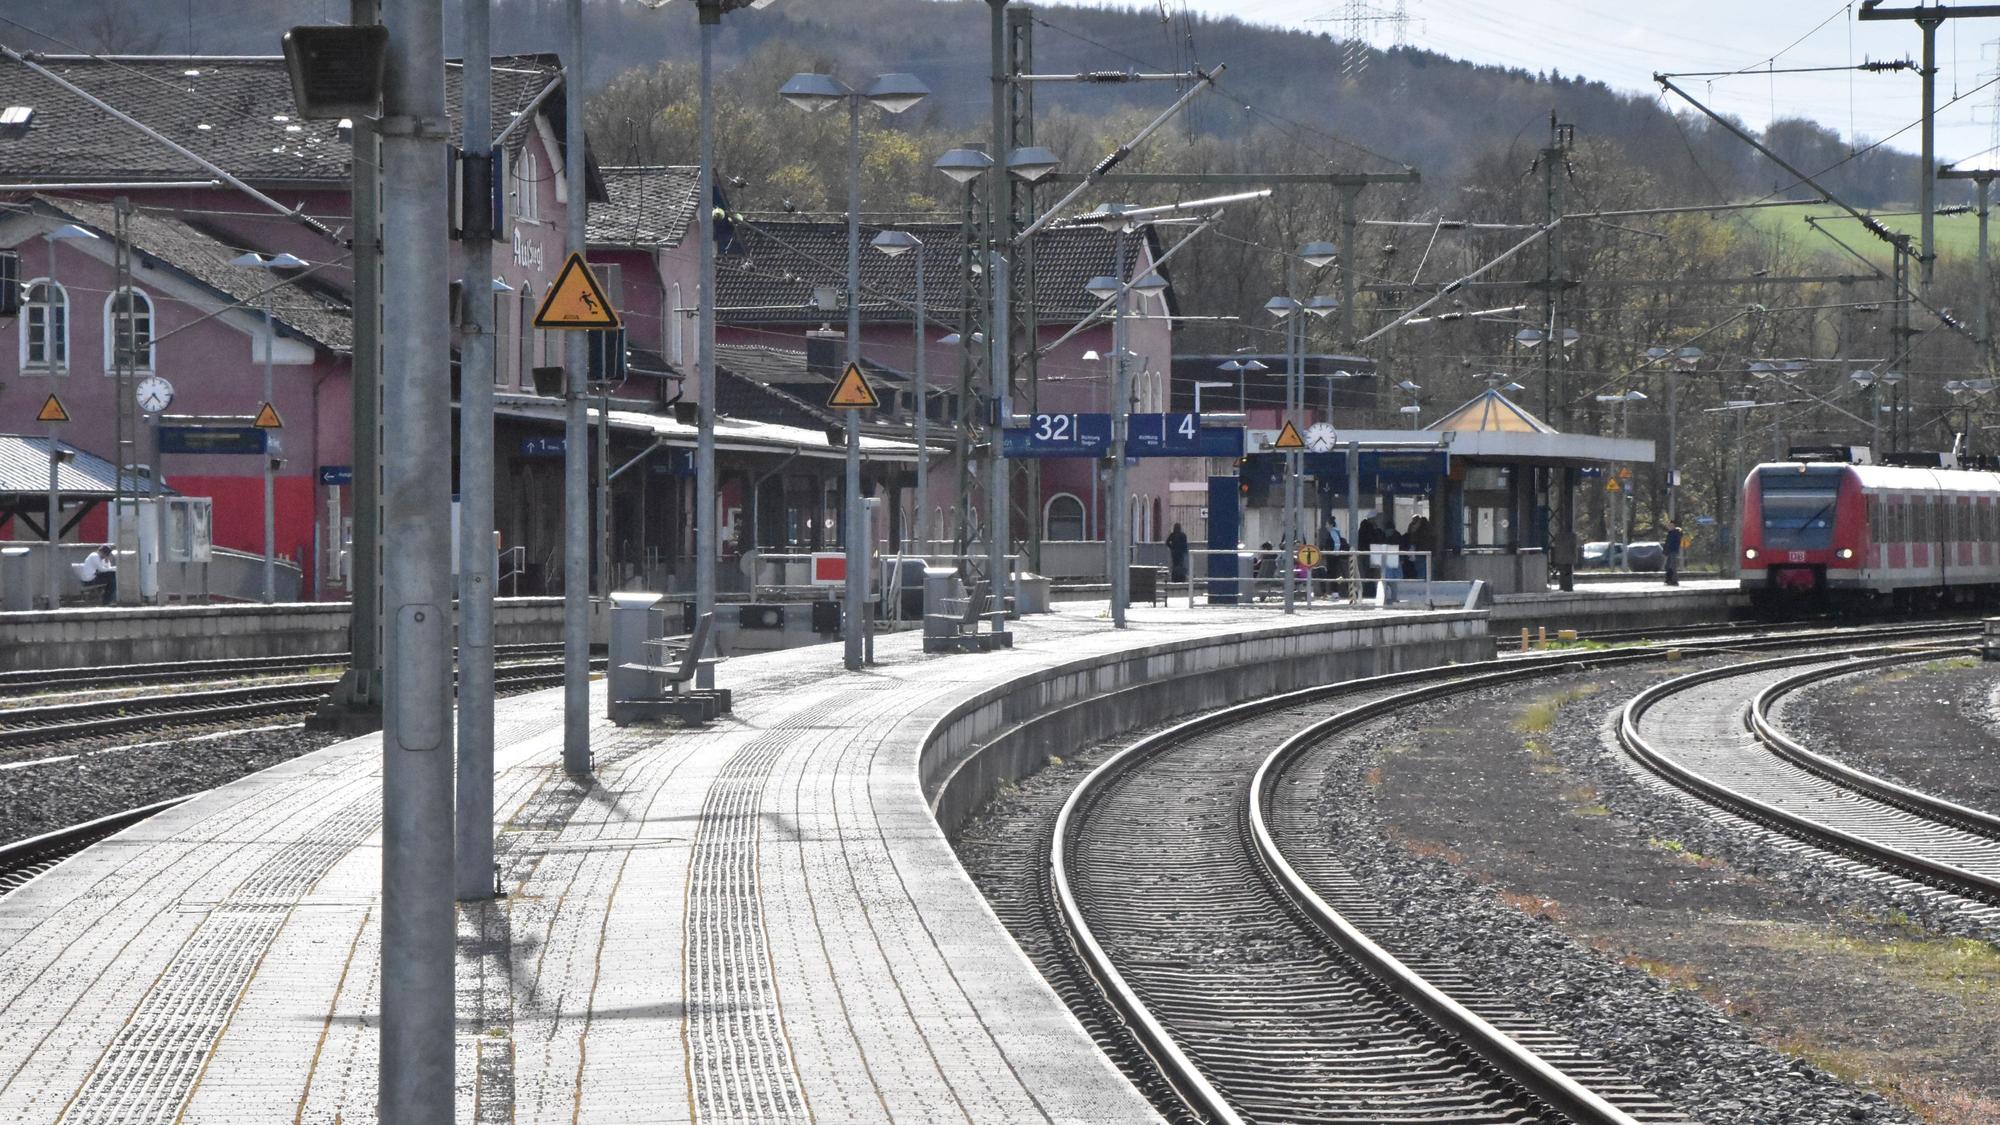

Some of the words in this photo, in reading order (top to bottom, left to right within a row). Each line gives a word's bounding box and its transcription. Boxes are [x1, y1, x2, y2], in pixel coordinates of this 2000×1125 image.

[1035, 414, 1069, 440] 32
[1179, 413, 1196, 439] 4
[684, 451, 693, 470] 1
